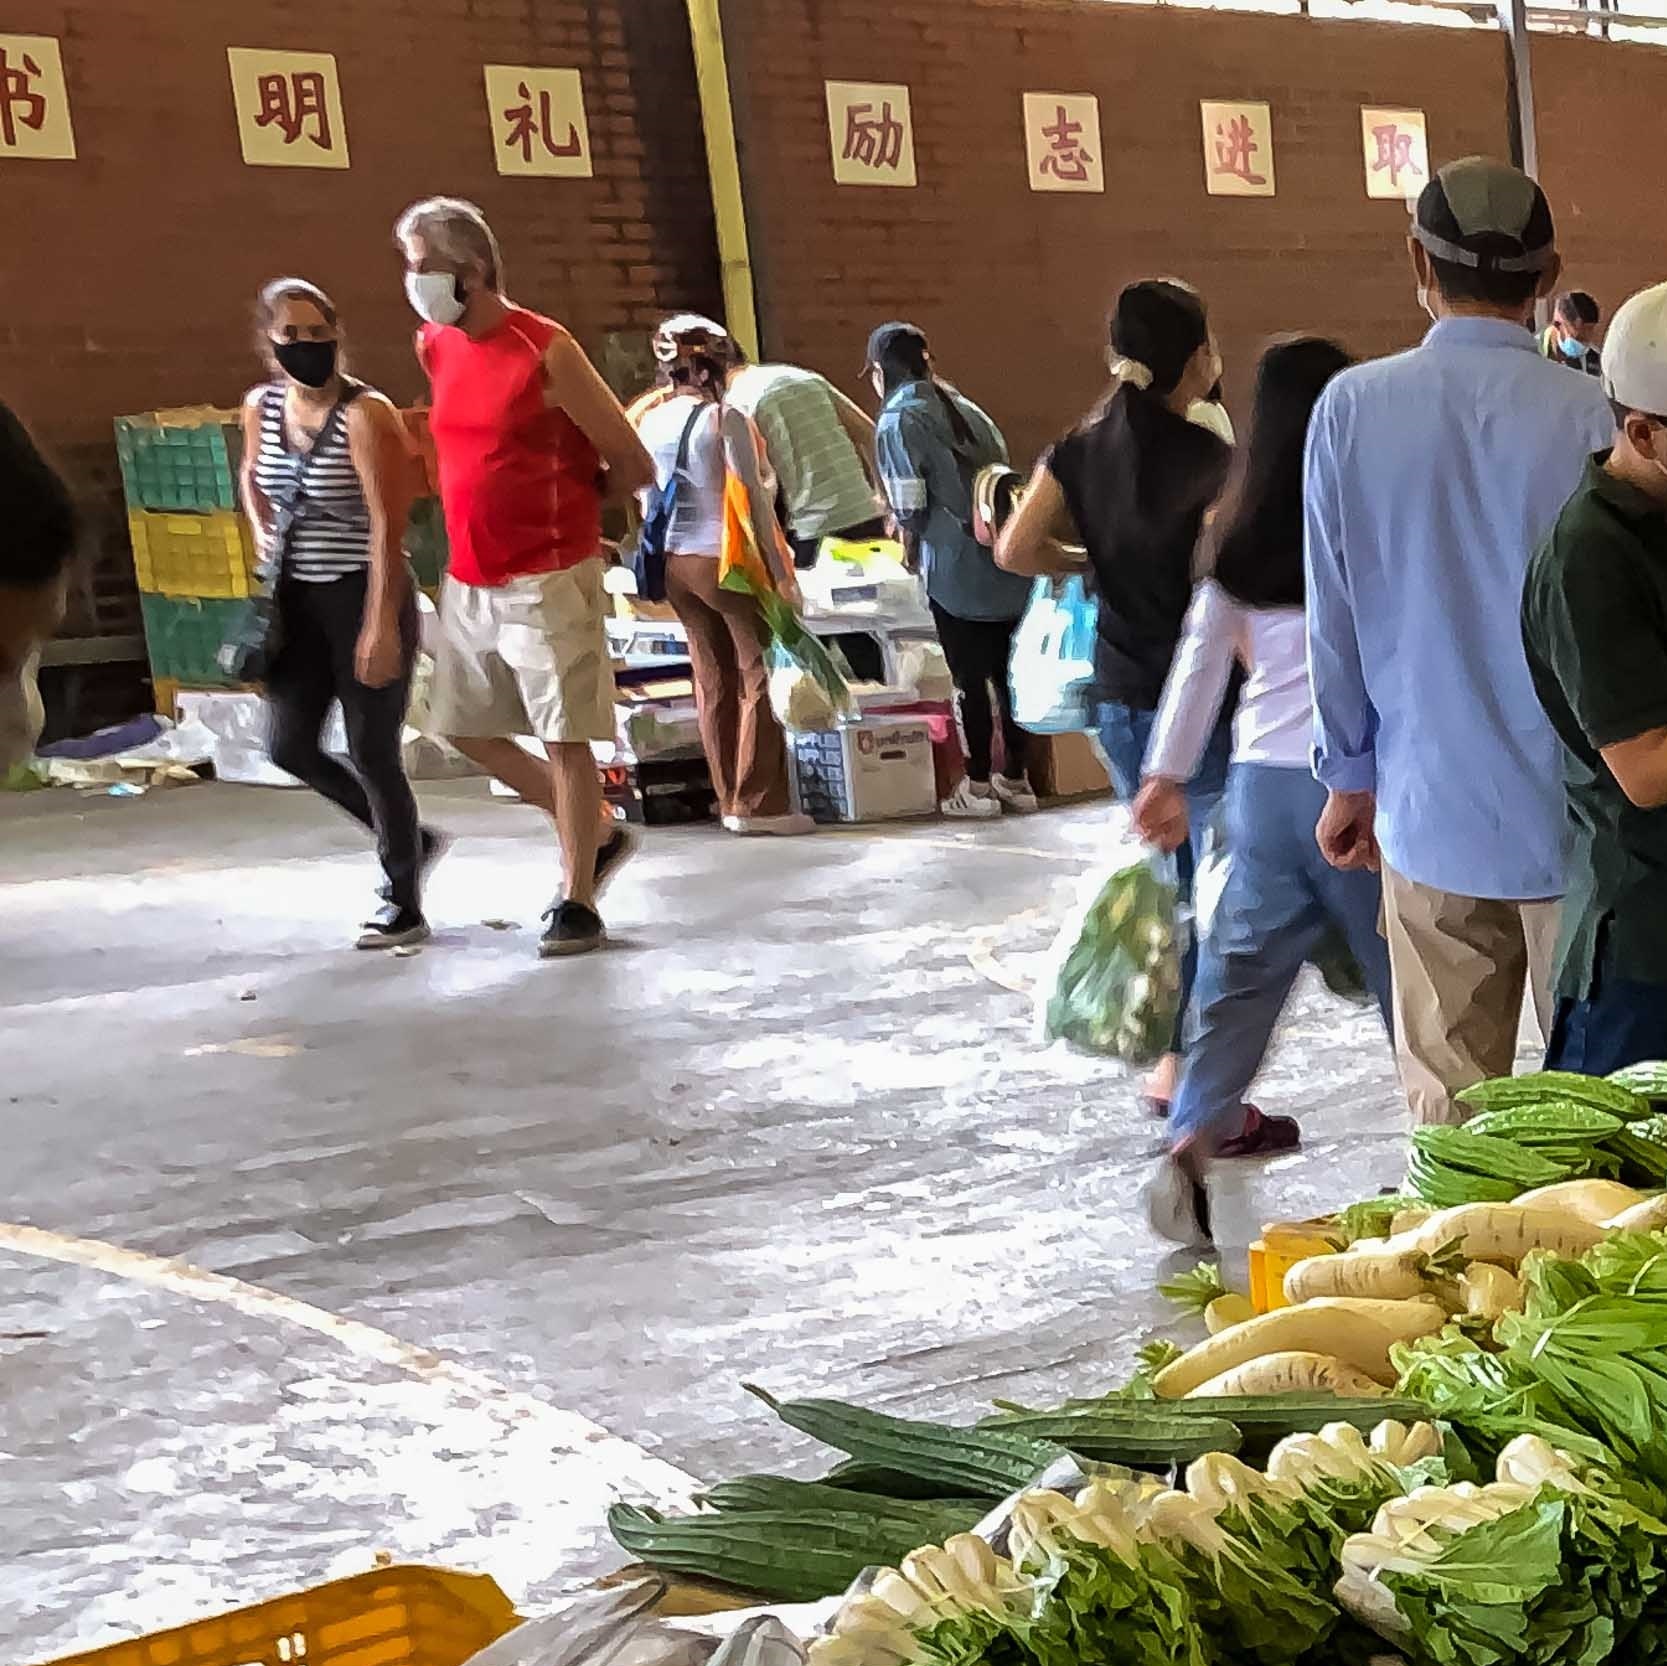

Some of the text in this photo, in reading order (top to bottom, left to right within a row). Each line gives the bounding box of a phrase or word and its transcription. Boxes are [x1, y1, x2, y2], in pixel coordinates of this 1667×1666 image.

[253, 72, 333, 150] 明
[504, 81, 582, 163] 礼
[842, 101, 1423, 187] 励 志 进 取
